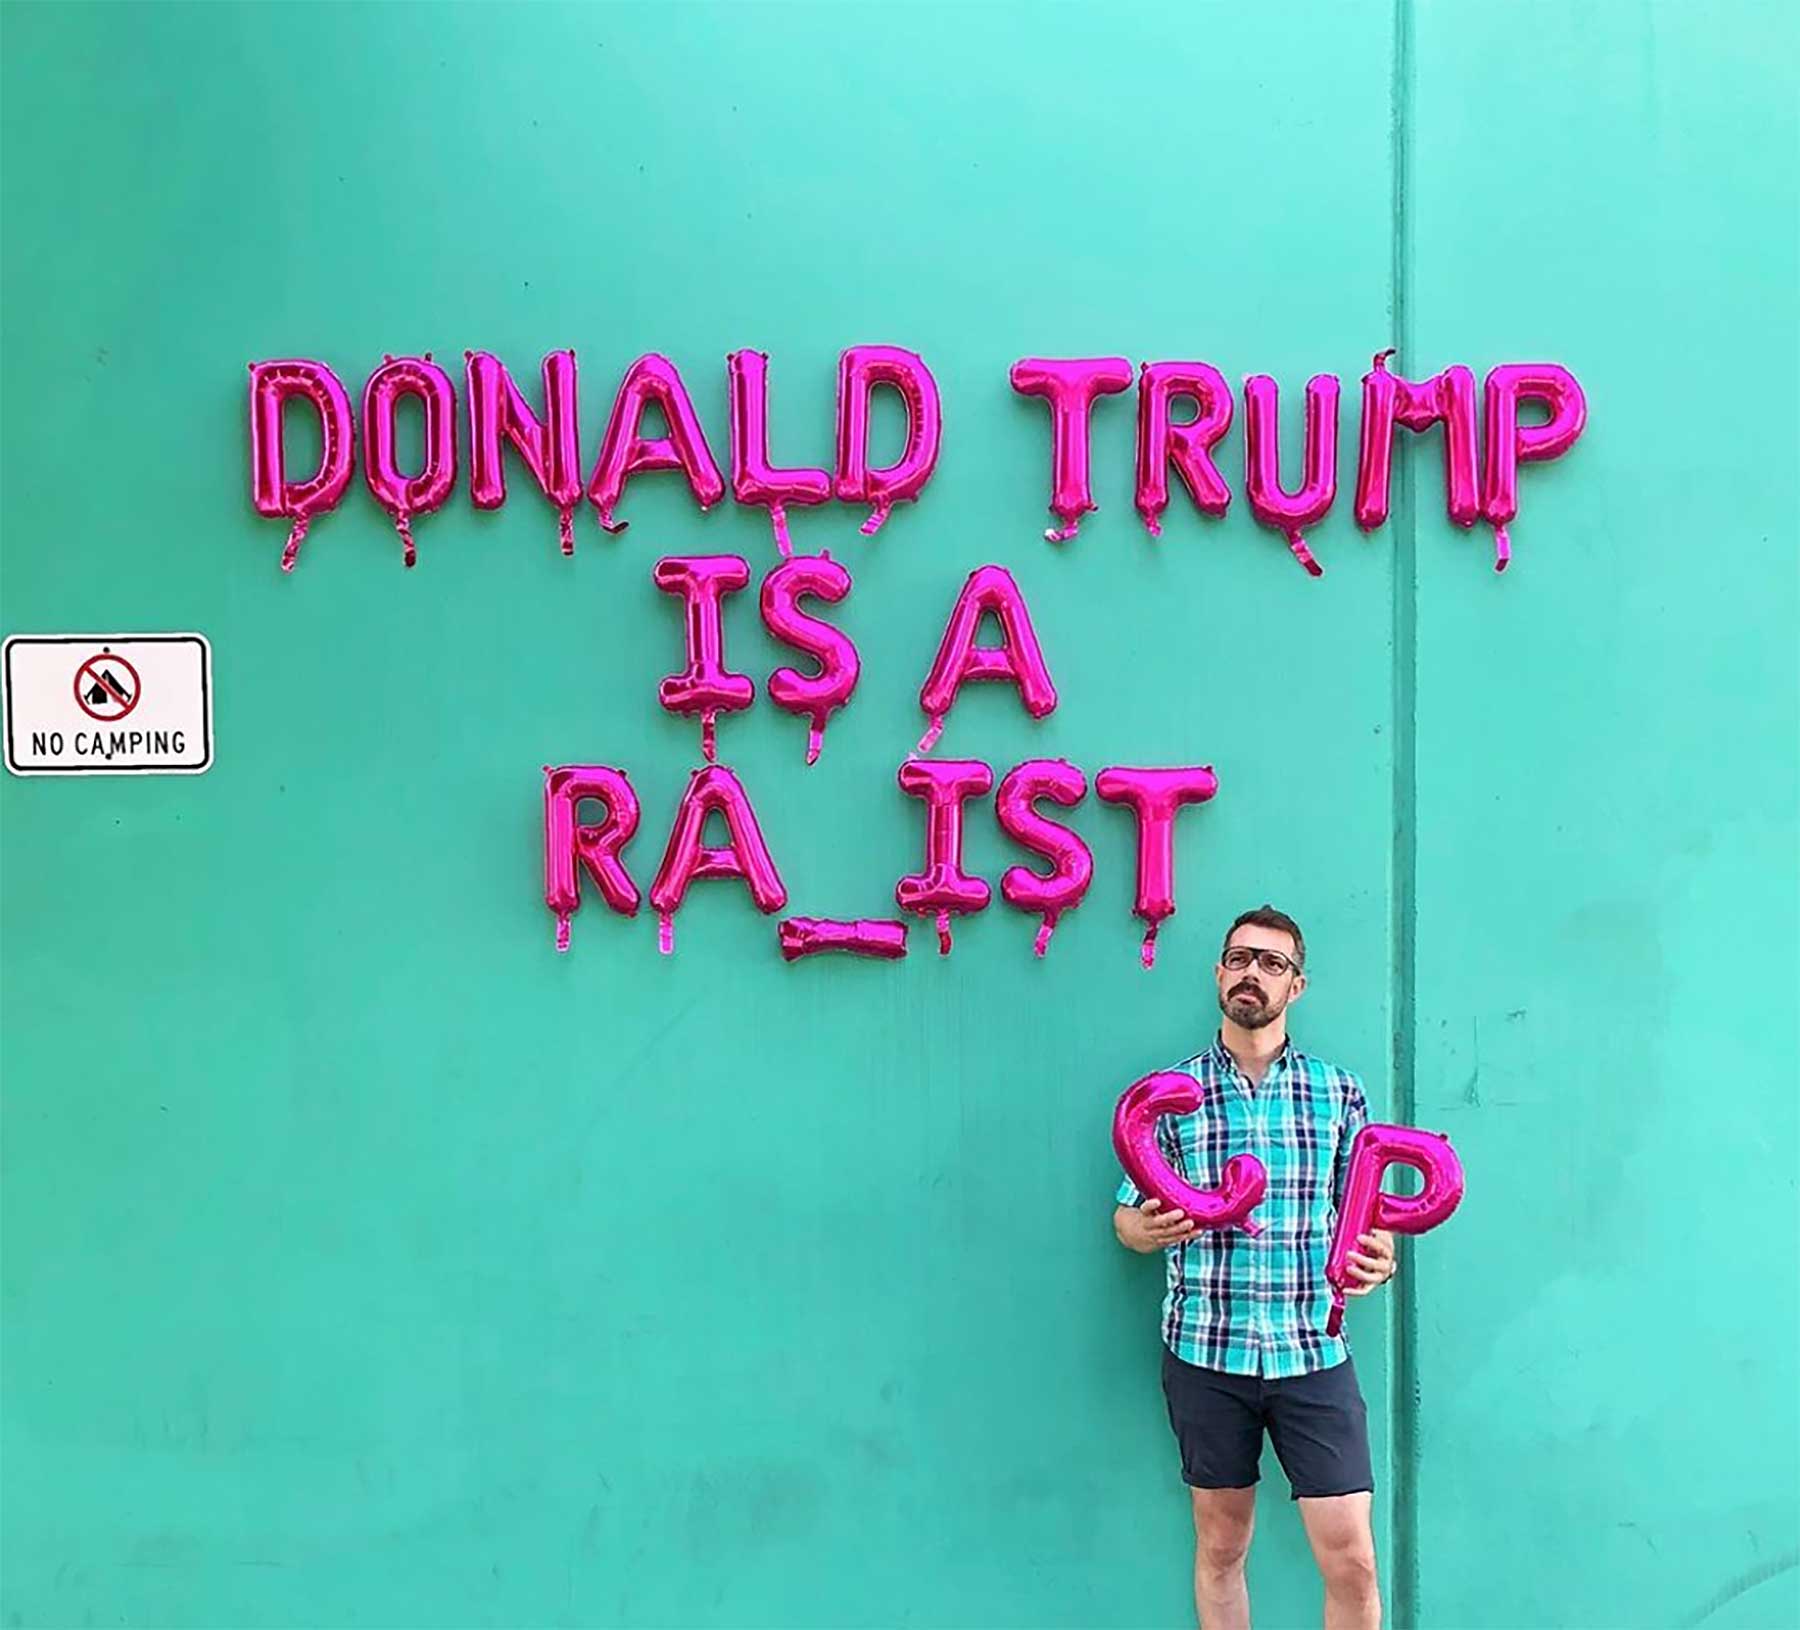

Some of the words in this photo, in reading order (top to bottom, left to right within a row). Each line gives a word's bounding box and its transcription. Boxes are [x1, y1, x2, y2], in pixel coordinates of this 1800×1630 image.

[249, 347, 941, 518] DONALD
[1010, 357, 1587, 530] TRUMP
[653, 554, 861, 715] IS
[919, 565, 1058, 720] A
[32, 732, 64, 756] NO
[75, 731, 186, 756] CAMPING
[1112, 1071, 1268, 1232] C
[1325, 1123, 1464, 1294] P
